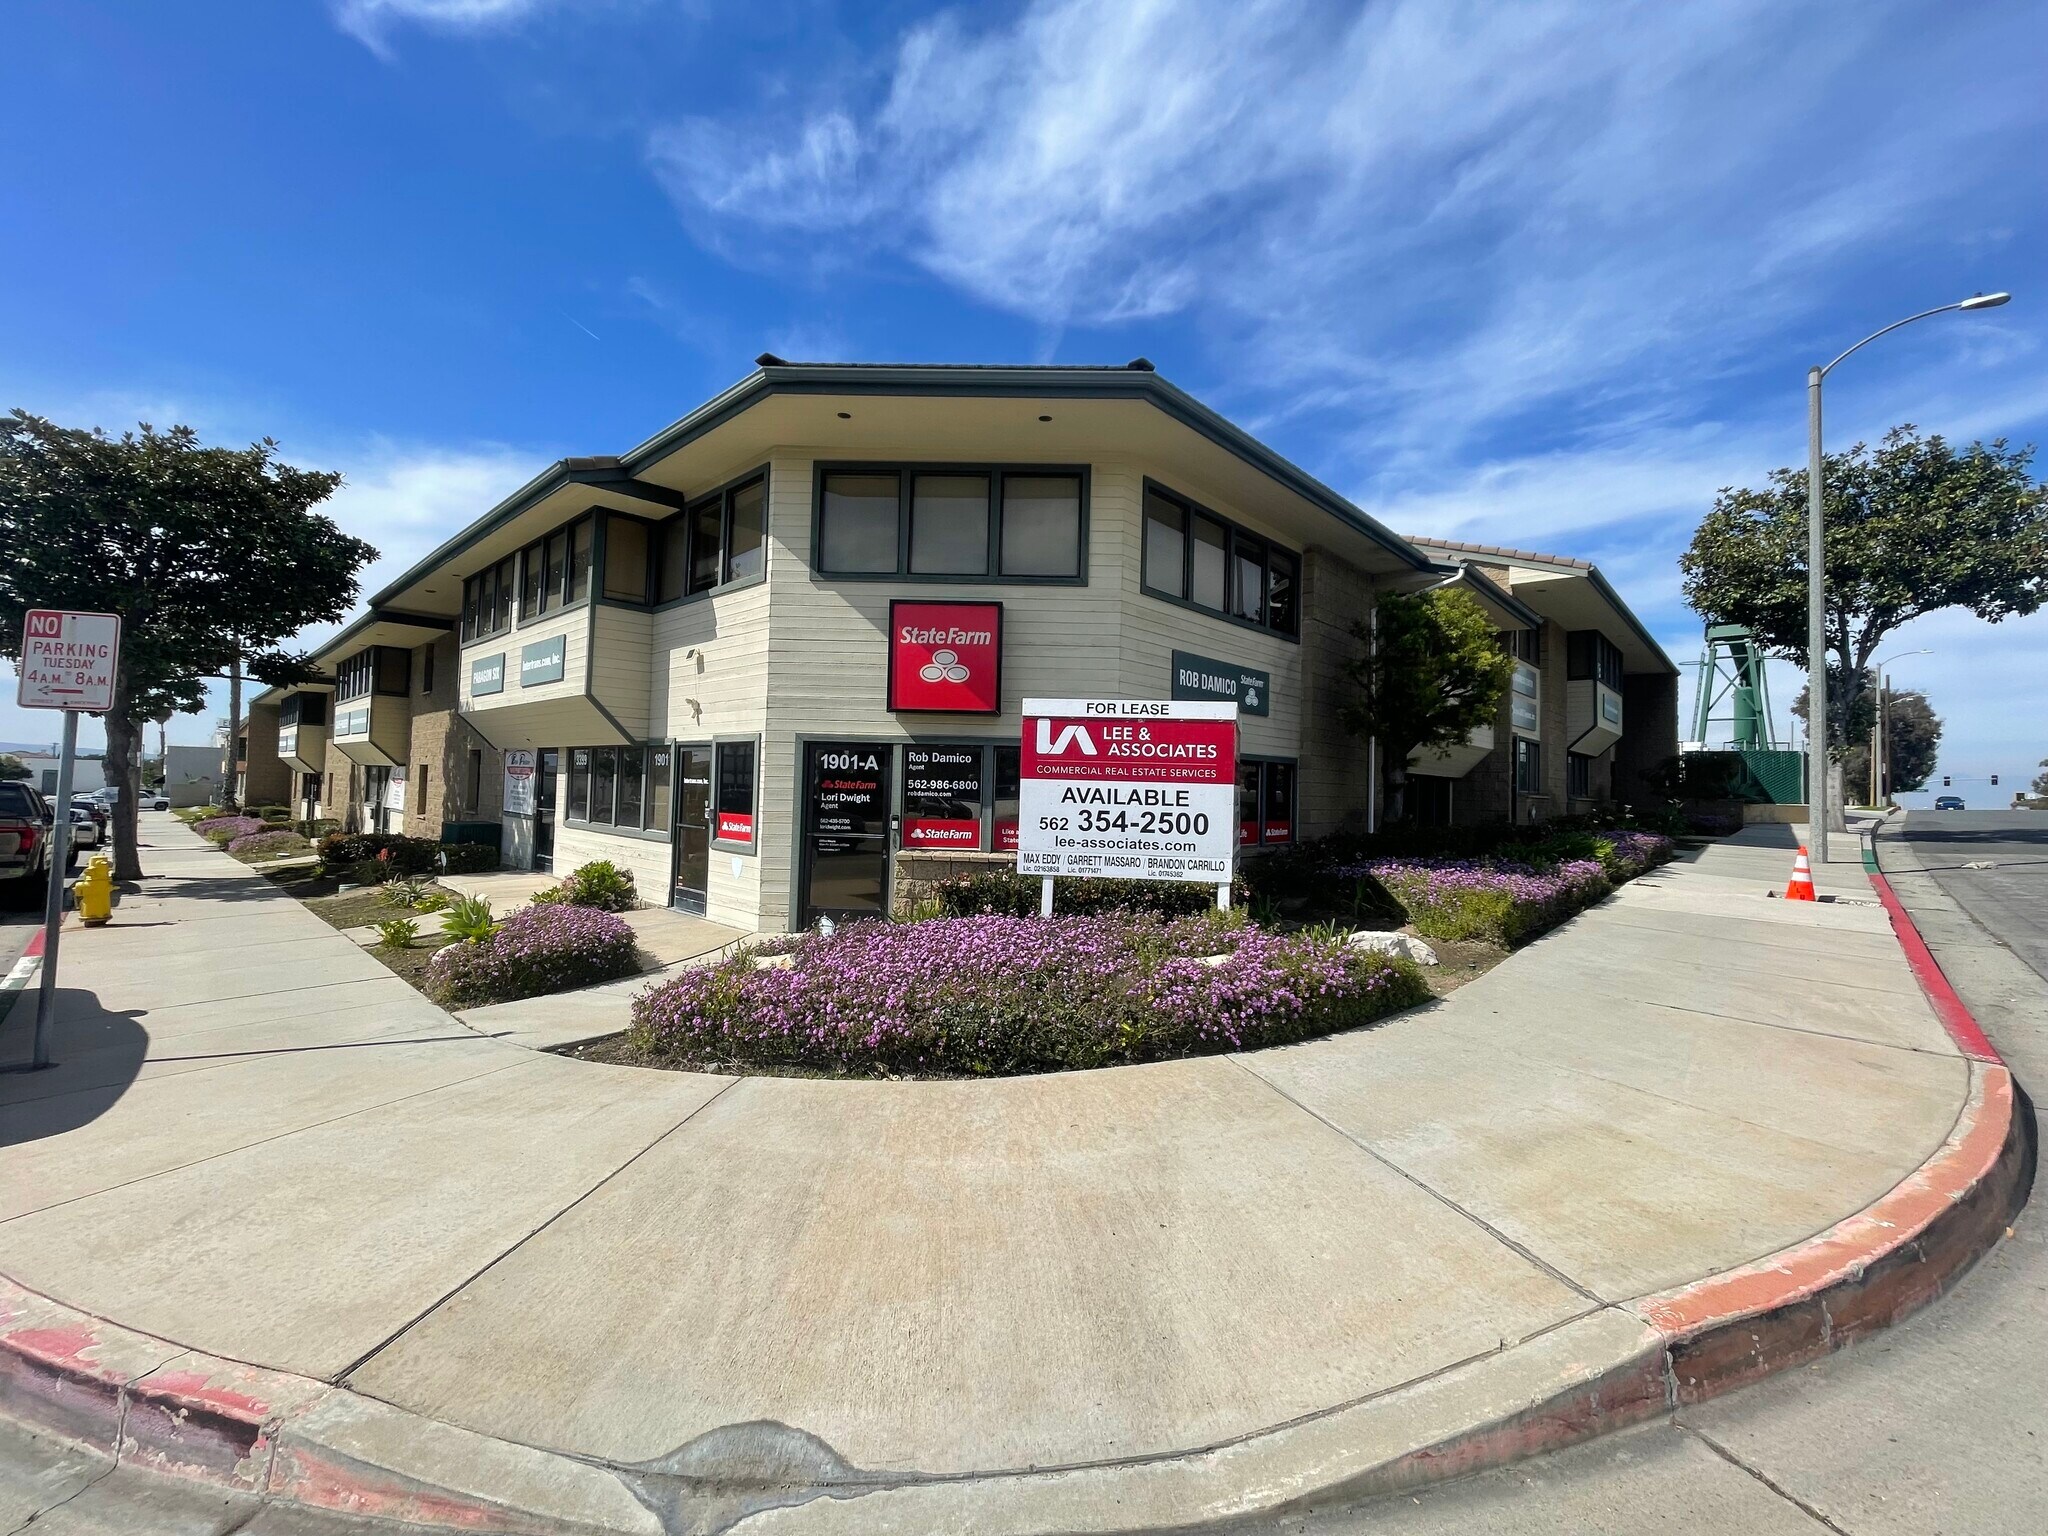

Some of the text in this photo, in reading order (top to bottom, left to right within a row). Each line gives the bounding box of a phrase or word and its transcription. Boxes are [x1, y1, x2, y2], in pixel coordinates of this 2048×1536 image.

[31, 616, 58, 635] NO
[33, 641, 108, 658] PARKING
[43, 657, 95, 670] TUESDAY
[1180, 669, 1237, 695] ROB DAMICO
[1086, 703, 1170, 715] FOR LEASE
[1103, 727, 1151, 741] LEE &
[908, 752, 972, 764] Rob Damico
[1108, 743, 1217, 758] ASSOCIATES
[821, 753, 879, 771] 1901-A
[1036, 765, 1217, 778] COMMERCIAL REAL ESTATE SERVICES
[908, 780, 978, 790] 562-986-6800
[821, 793, 871, 804] Lori Dwight
[1061, 787, 1190, 807] AVAILABLE
[821, 802, 839, 810] Agent
[1039, 809, 1209, 835] 562 354-2500
[1055, 836, 1196, 852] lee-associates.com
[1023, 853, 1040, 864] MAX
[1042, 853, 1061, 865] EDDY
[1067, 855, 1103, 866] GARRETT
[1104, 856, 1141, 868] MASSARO
[1148, 858, 1185, 870] BRANDON
[1187, 859, 1225, 872] CARRILLO
